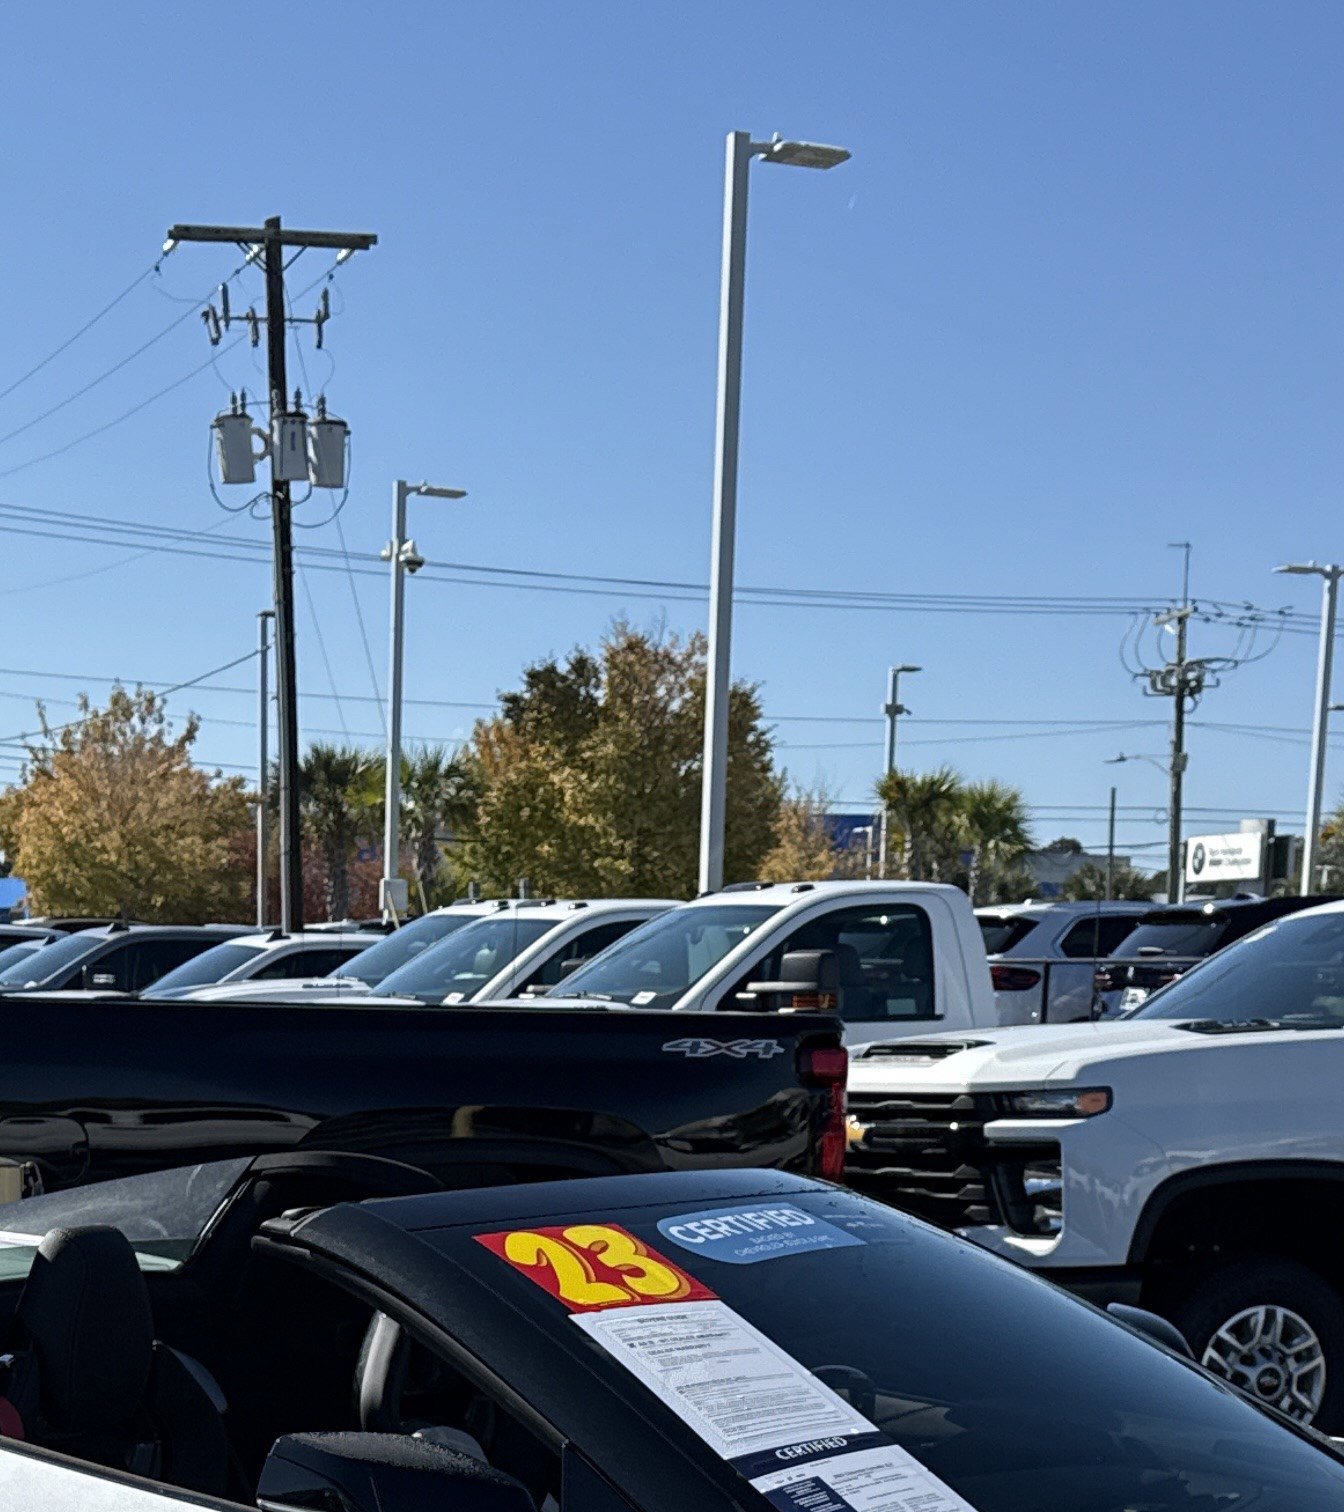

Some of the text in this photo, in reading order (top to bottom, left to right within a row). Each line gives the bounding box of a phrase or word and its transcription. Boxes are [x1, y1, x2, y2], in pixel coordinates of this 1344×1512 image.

[668, 1208, 816, 1244] CERTIFIED
[504, 1224, 692, 1307] 23
[774, 1435, 849, 1461] CERTIFIED
